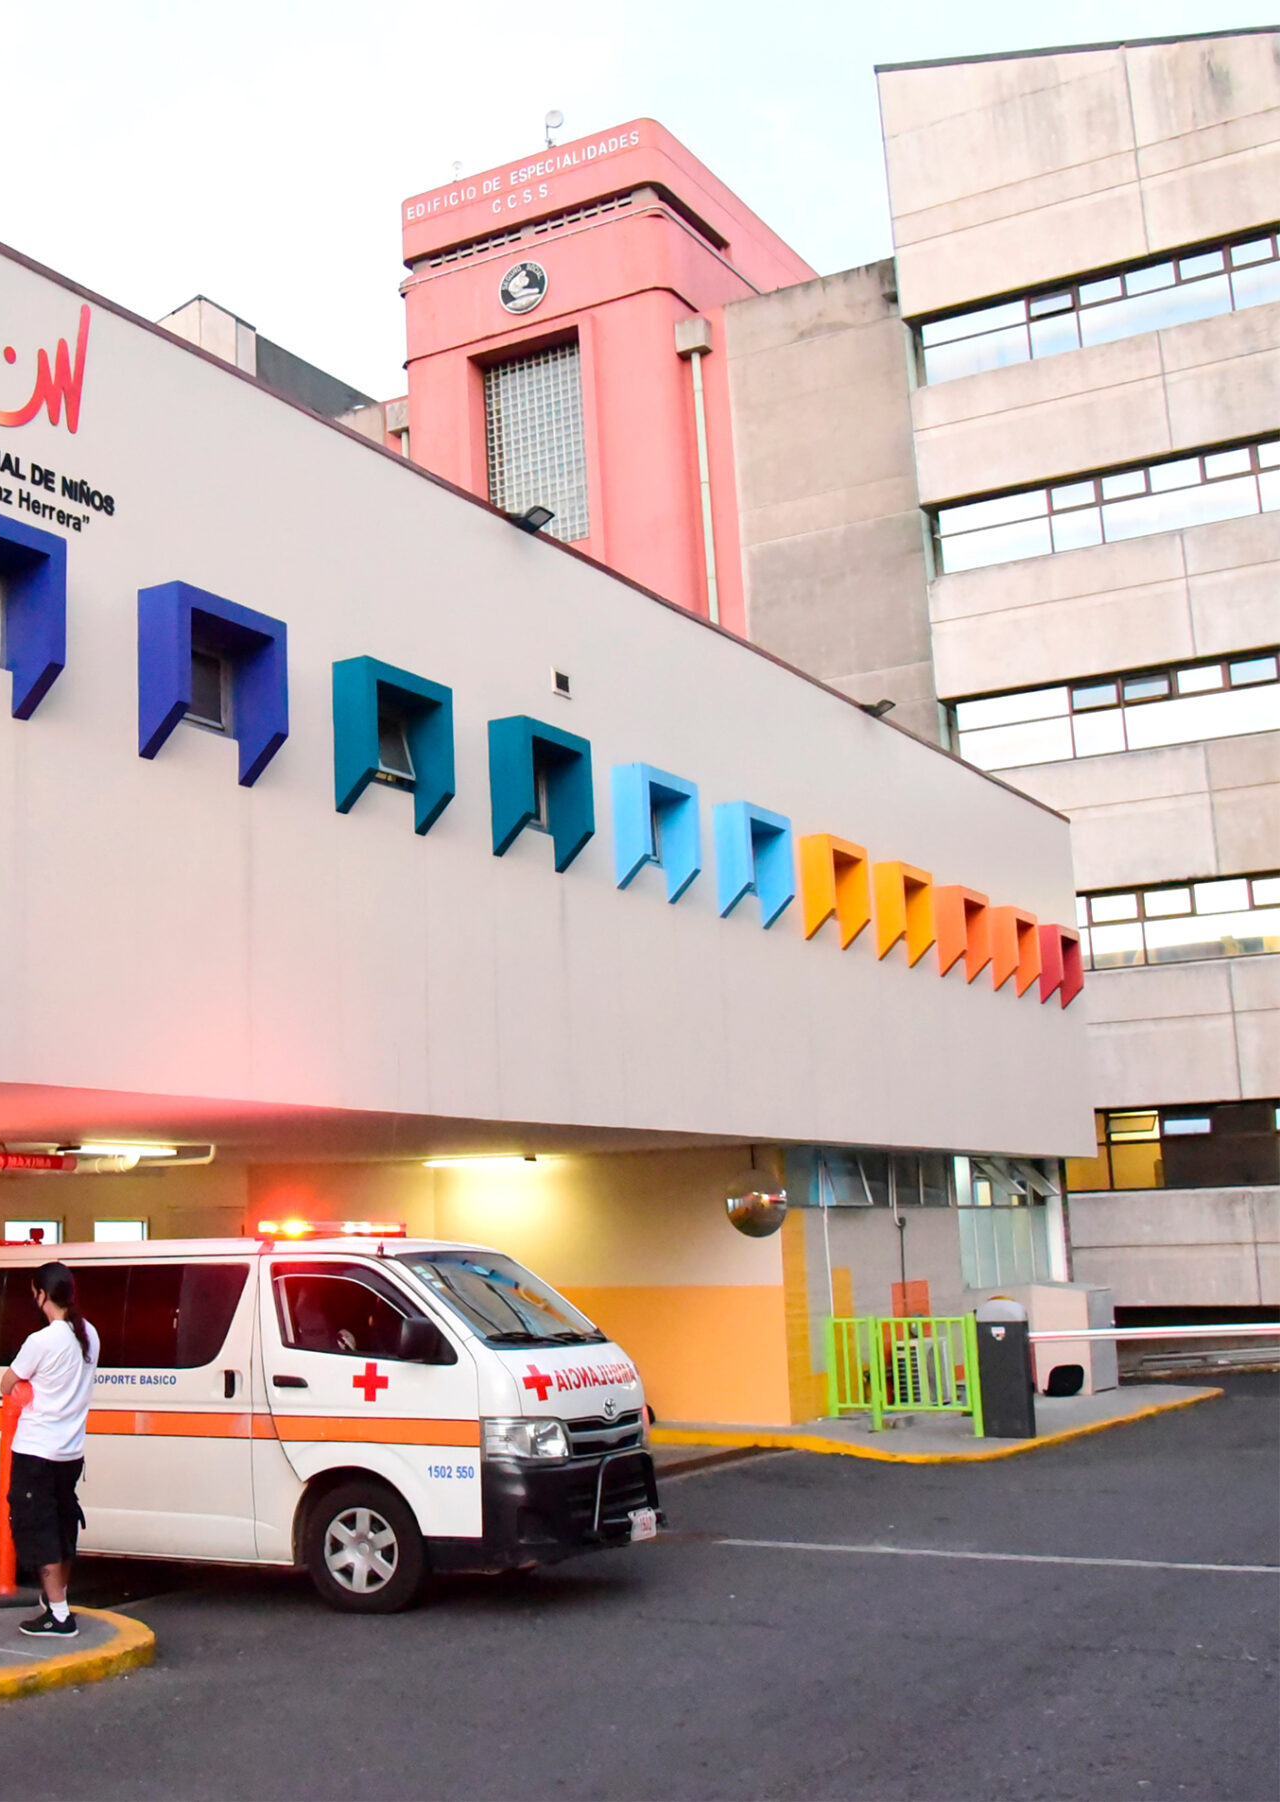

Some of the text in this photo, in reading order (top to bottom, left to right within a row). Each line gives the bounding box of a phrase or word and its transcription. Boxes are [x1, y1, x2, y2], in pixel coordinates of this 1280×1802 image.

[406, 130, 640, 220] EDIFICIO DE ESPECIALIDADES
[30, 463, 56, 492] DE
[61, 476, 116, 516] NIÑOS
[7, 1156, 52, 1170] MAXIMA
[139, 1375, 177, 1386] BASICO
[427, 1465, 475, 1480] 1502 550
